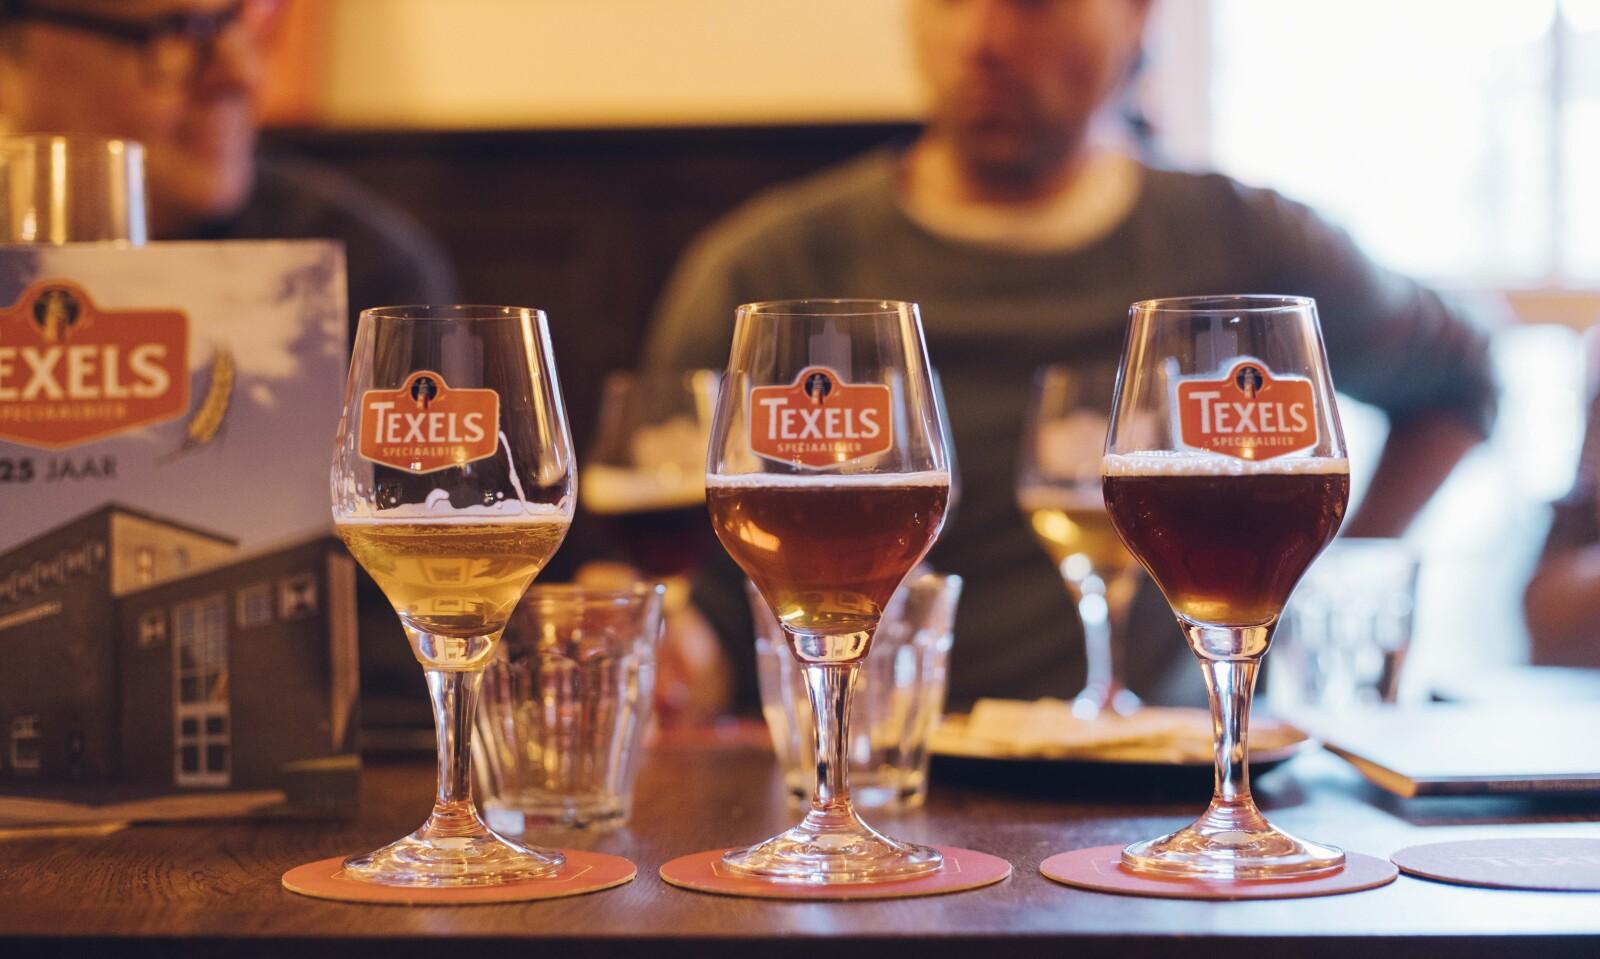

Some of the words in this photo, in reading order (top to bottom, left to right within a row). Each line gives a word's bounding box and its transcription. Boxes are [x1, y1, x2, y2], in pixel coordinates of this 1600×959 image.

[0, 344, 171, 400] EXELS
[369, 401, 485, 444] TEXELS
[760, 397, 880, 440] TEXELS
[1189, 391, 1308, 434] TEXELS
[46, 454, 117, 482] JAAR
